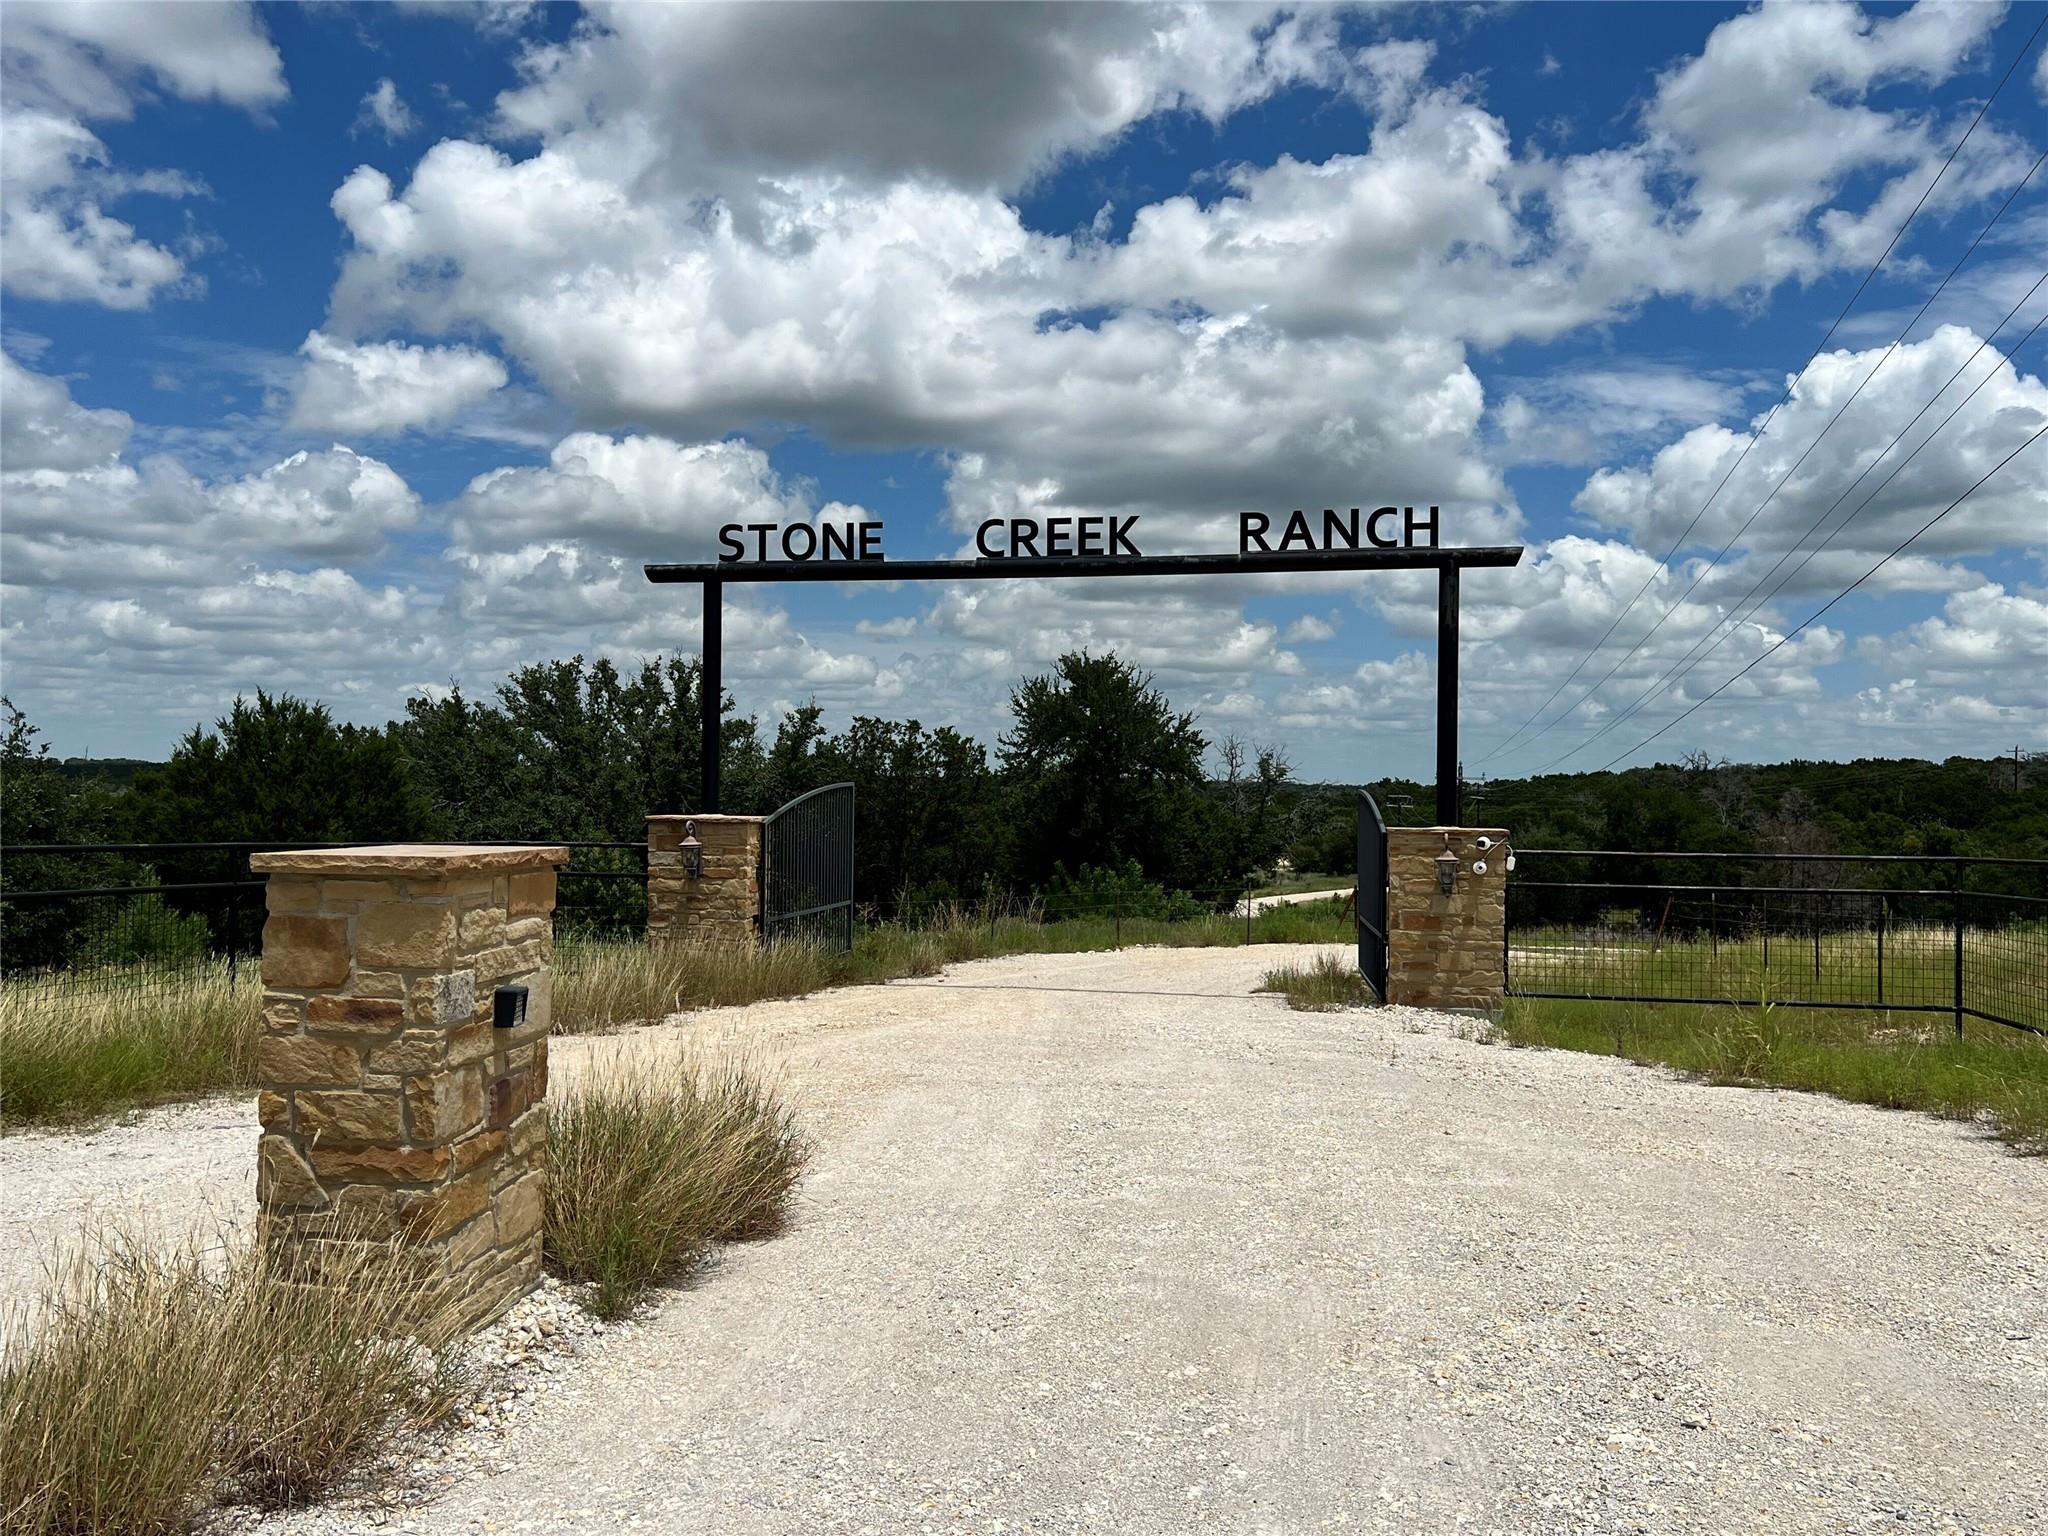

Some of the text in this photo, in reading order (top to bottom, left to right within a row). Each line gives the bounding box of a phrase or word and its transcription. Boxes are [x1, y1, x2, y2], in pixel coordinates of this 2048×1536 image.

[719, 506, 1439, 562] STONE CREEK RANCH
